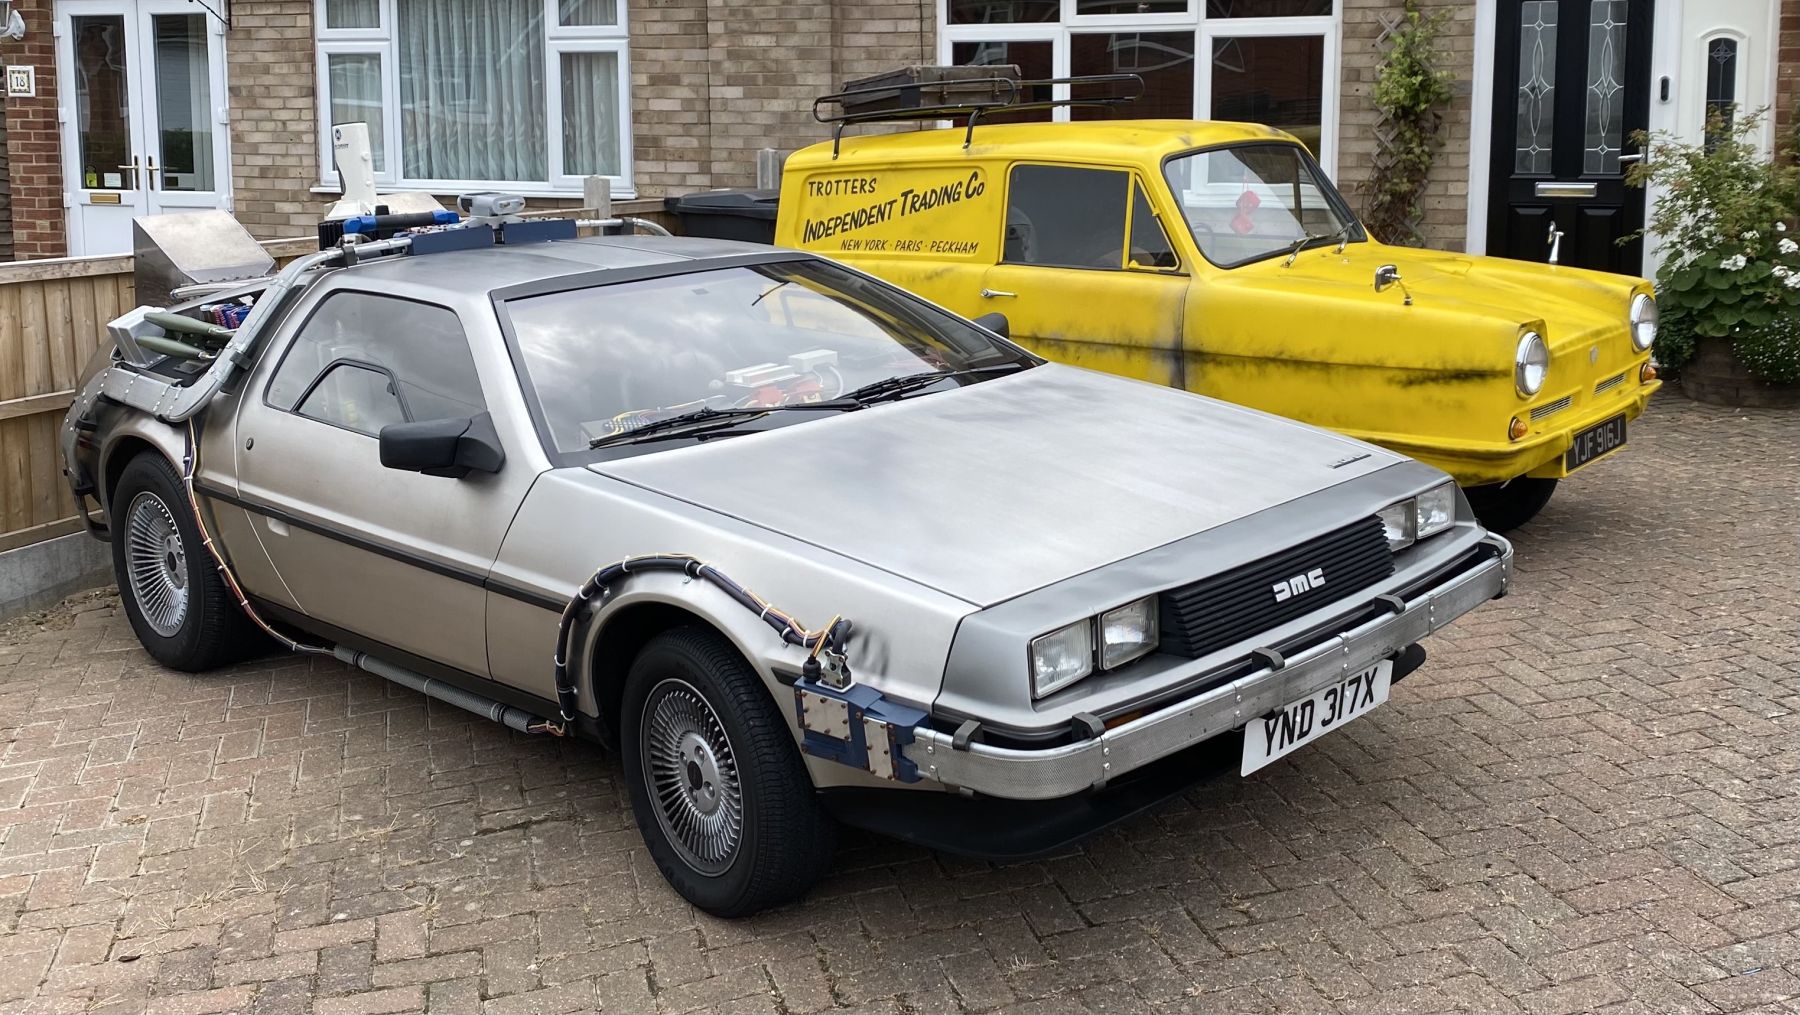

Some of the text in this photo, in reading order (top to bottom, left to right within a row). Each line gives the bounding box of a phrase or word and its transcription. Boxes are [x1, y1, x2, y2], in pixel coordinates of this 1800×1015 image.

[15, 76, 26, 87] 18
[808, 177, 877, 197] TROTTERS
[802, 199, 898, 244] INDEPENDENT
[900, 181, 963, 217] TRADING
[840, 239, 979, 254] NEW YORK PARIS PECKHAM
[1573, 418, 1621, 465] YJF 916J
[1264, 666, 1378, 757] YND 317X
